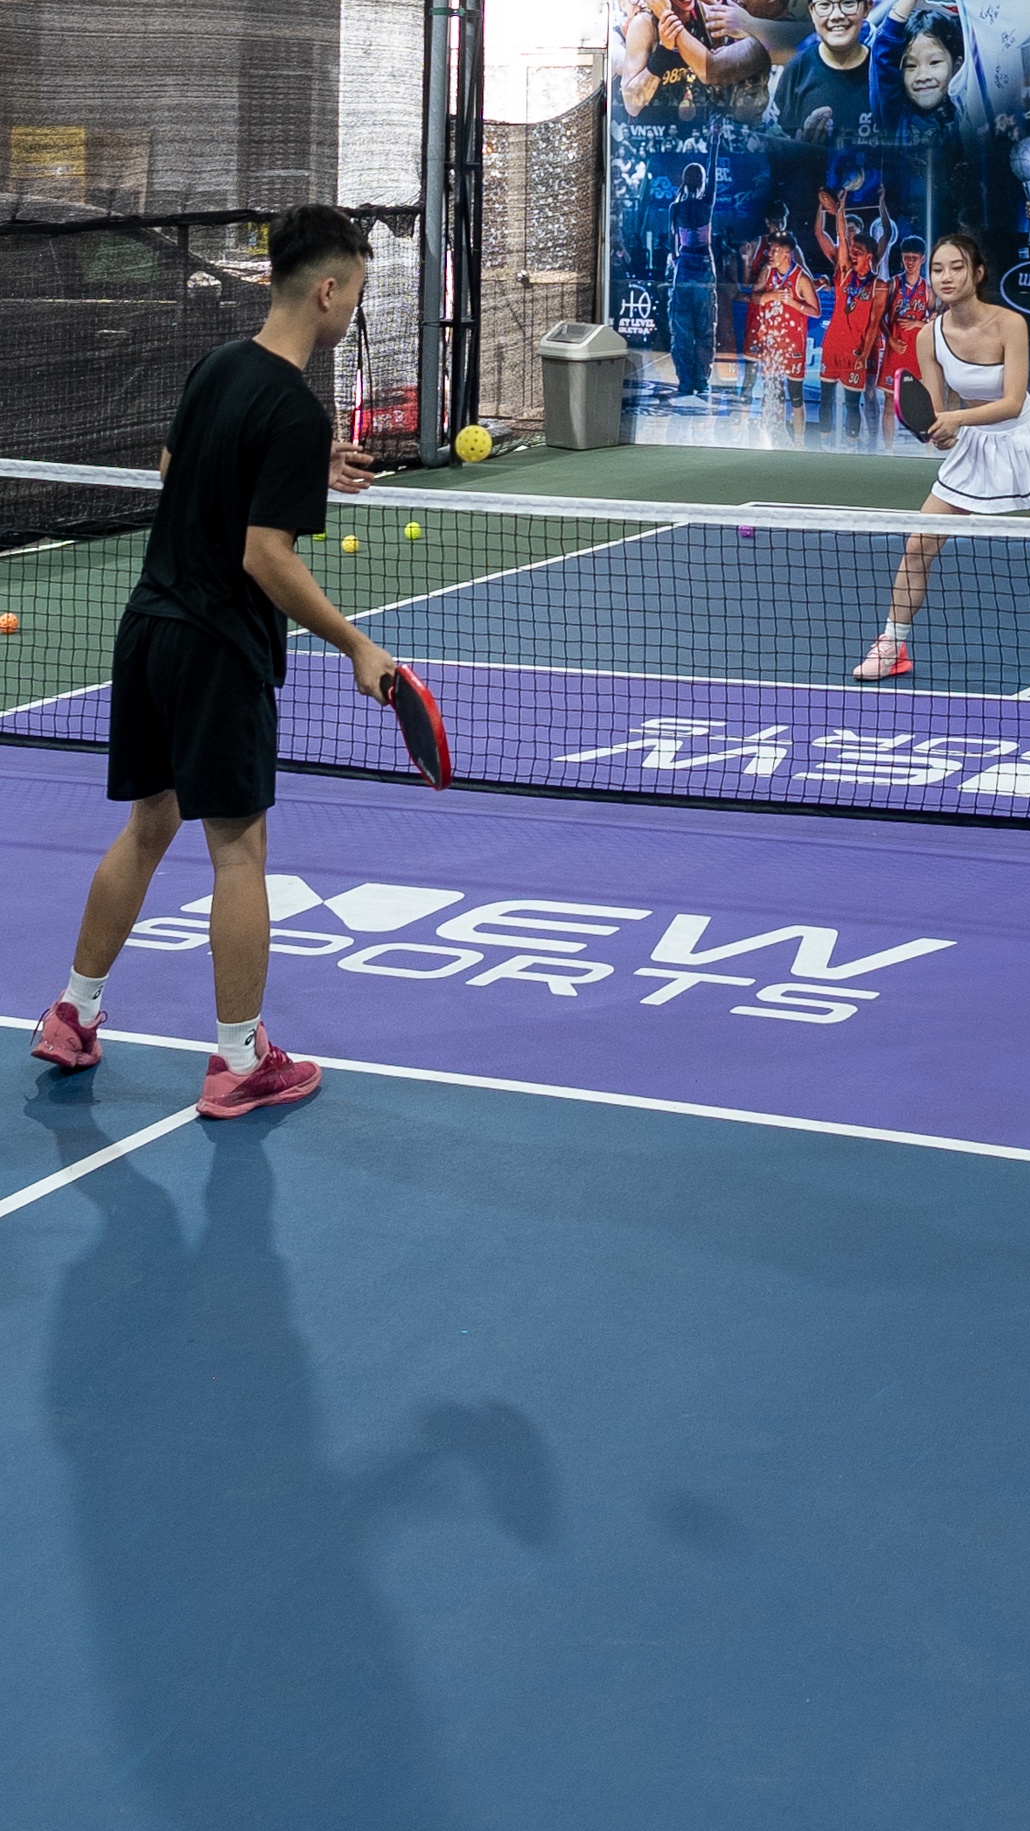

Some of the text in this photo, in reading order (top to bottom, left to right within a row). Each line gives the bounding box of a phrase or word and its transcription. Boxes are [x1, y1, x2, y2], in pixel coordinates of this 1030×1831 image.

[848, 372, 859, 384] 30
[126, 916, 880, 1025] SPORTS
[179, 873, 958, 980] NEW
